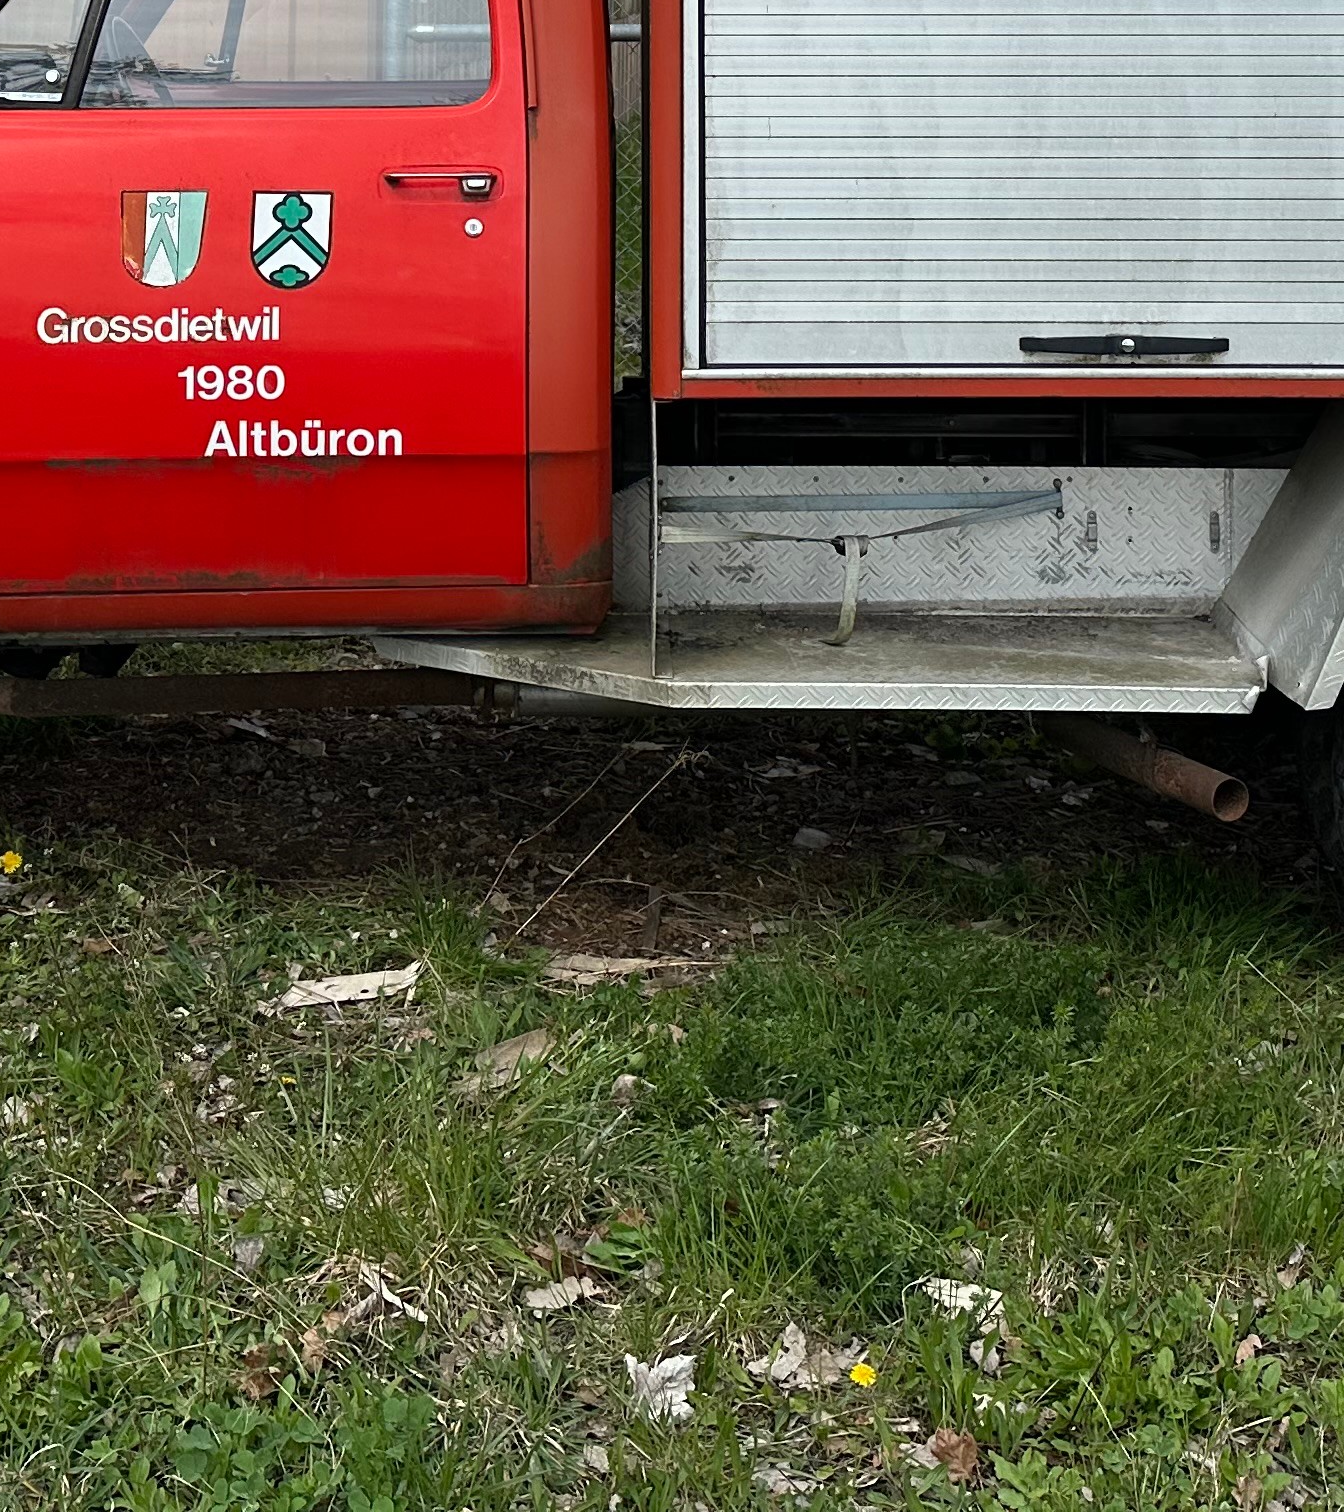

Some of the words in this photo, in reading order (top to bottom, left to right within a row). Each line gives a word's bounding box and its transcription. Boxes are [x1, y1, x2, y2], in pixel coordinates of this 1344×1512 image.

[37, 306, 280, 344] Grossdietwil
[178, 365, 286, 400] 1980
[204, 420, 403, 457] Altbüron
